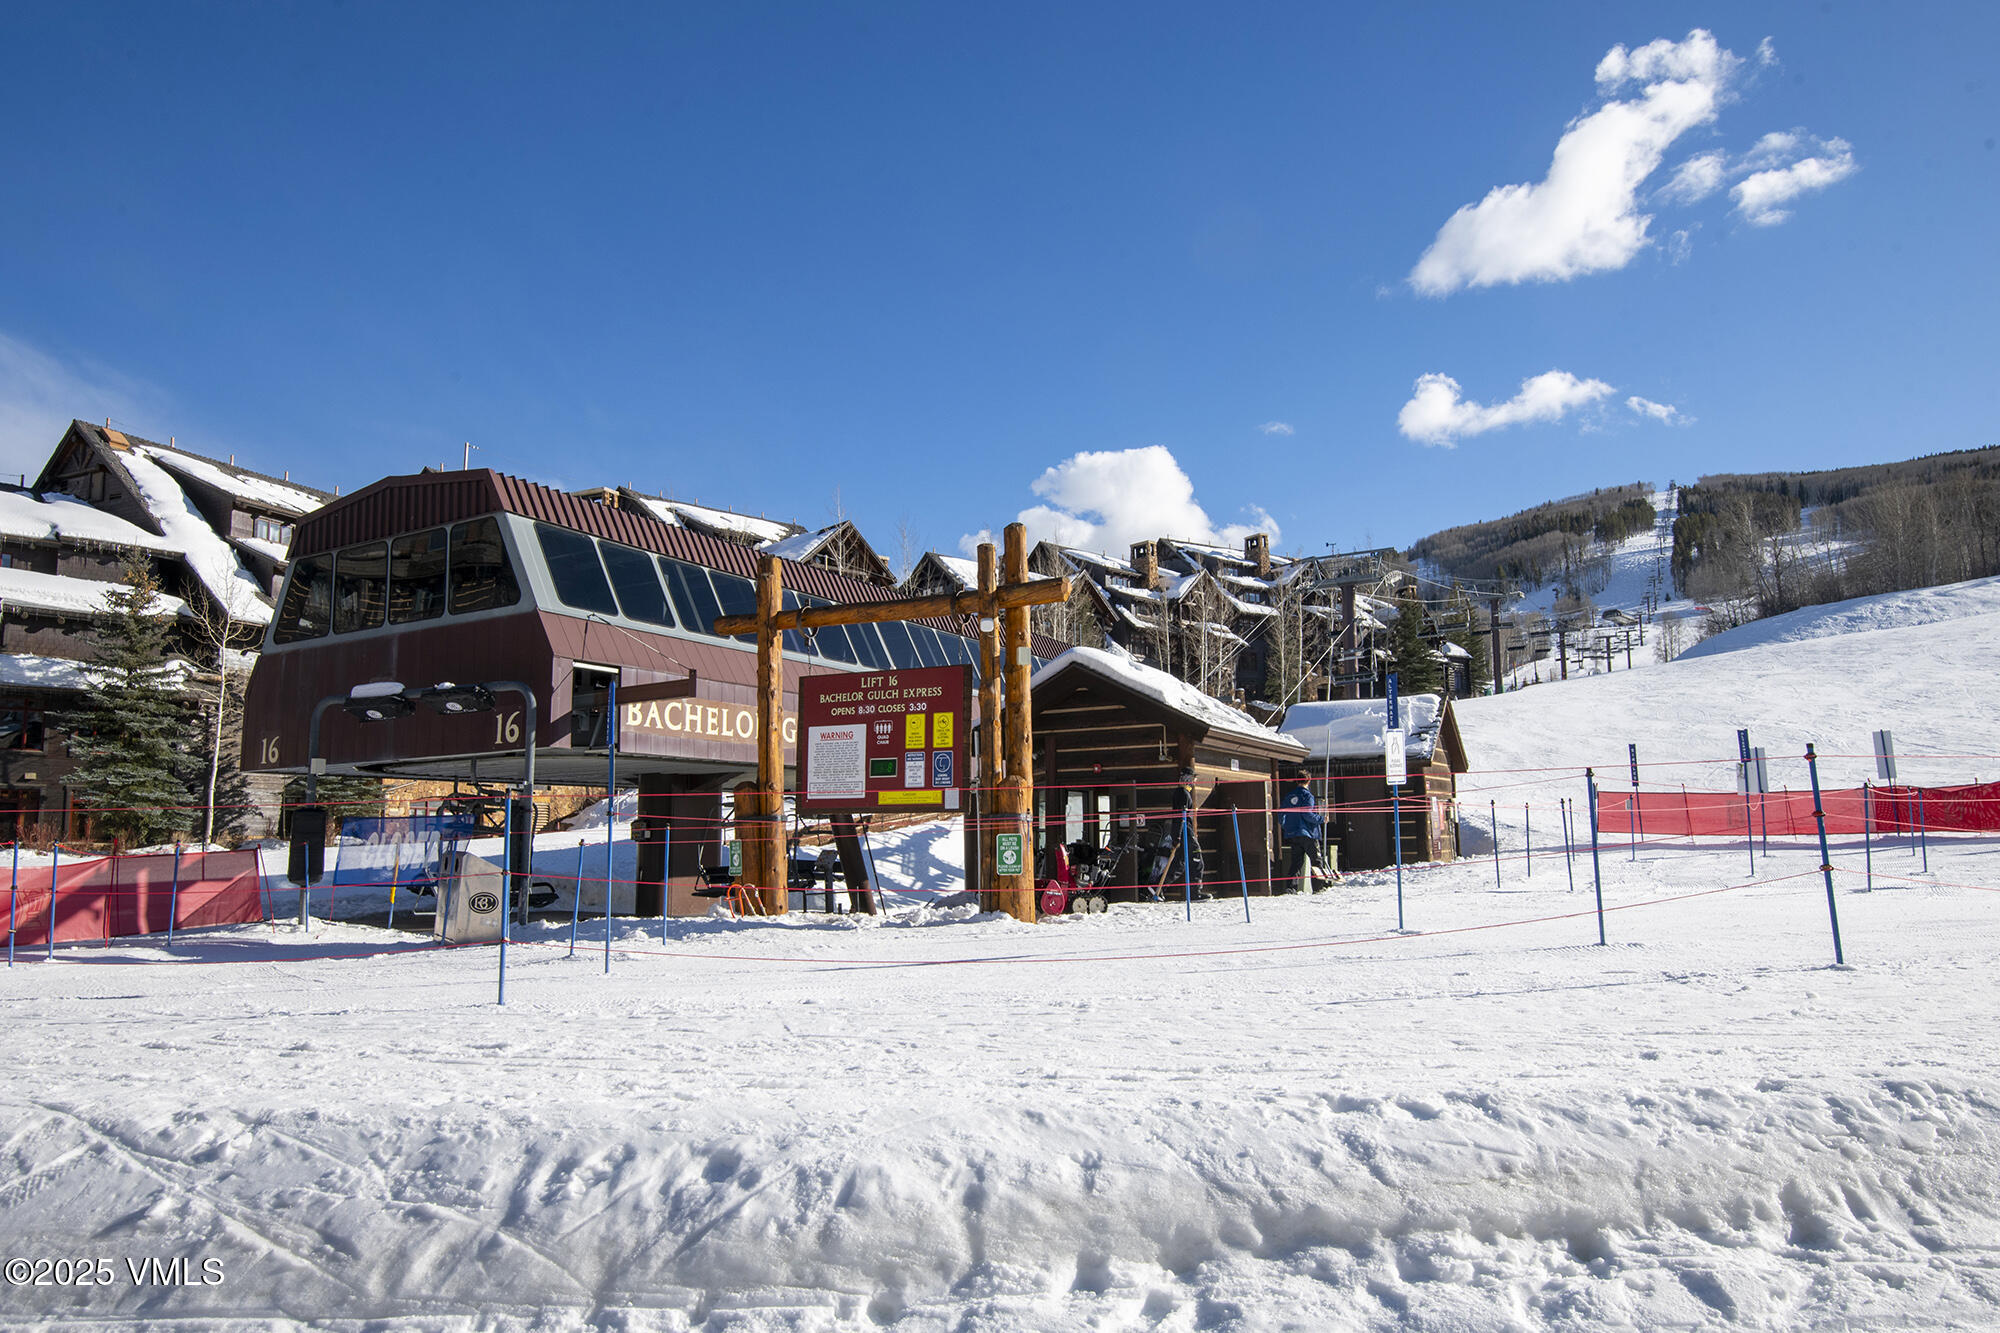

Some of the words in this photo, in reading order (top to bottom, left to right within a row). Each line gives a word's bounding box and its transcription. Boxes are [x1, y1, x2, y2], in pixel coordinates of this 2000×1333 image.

[861, 676, 884, 688] LIFT
[888, 675, 898, 687] 16
[820, 691, 864, 704] BACHELOR
[867, 689, 899, 700] GULCH
[903, 686, 942, 698] EXPRESS
[830, 706, 856, 716] OPENS
[858, 705, 875, 715] 8:30
[878, 703, 906, 713] CLOSES
[909, 702, 927, 712] 3:30
[494, 711, 520, 744] 16
[626, 701, 759, 739] BACHELO
[820, 730, 854, 740] WARNING
[260, 735, 279, 764] 16
